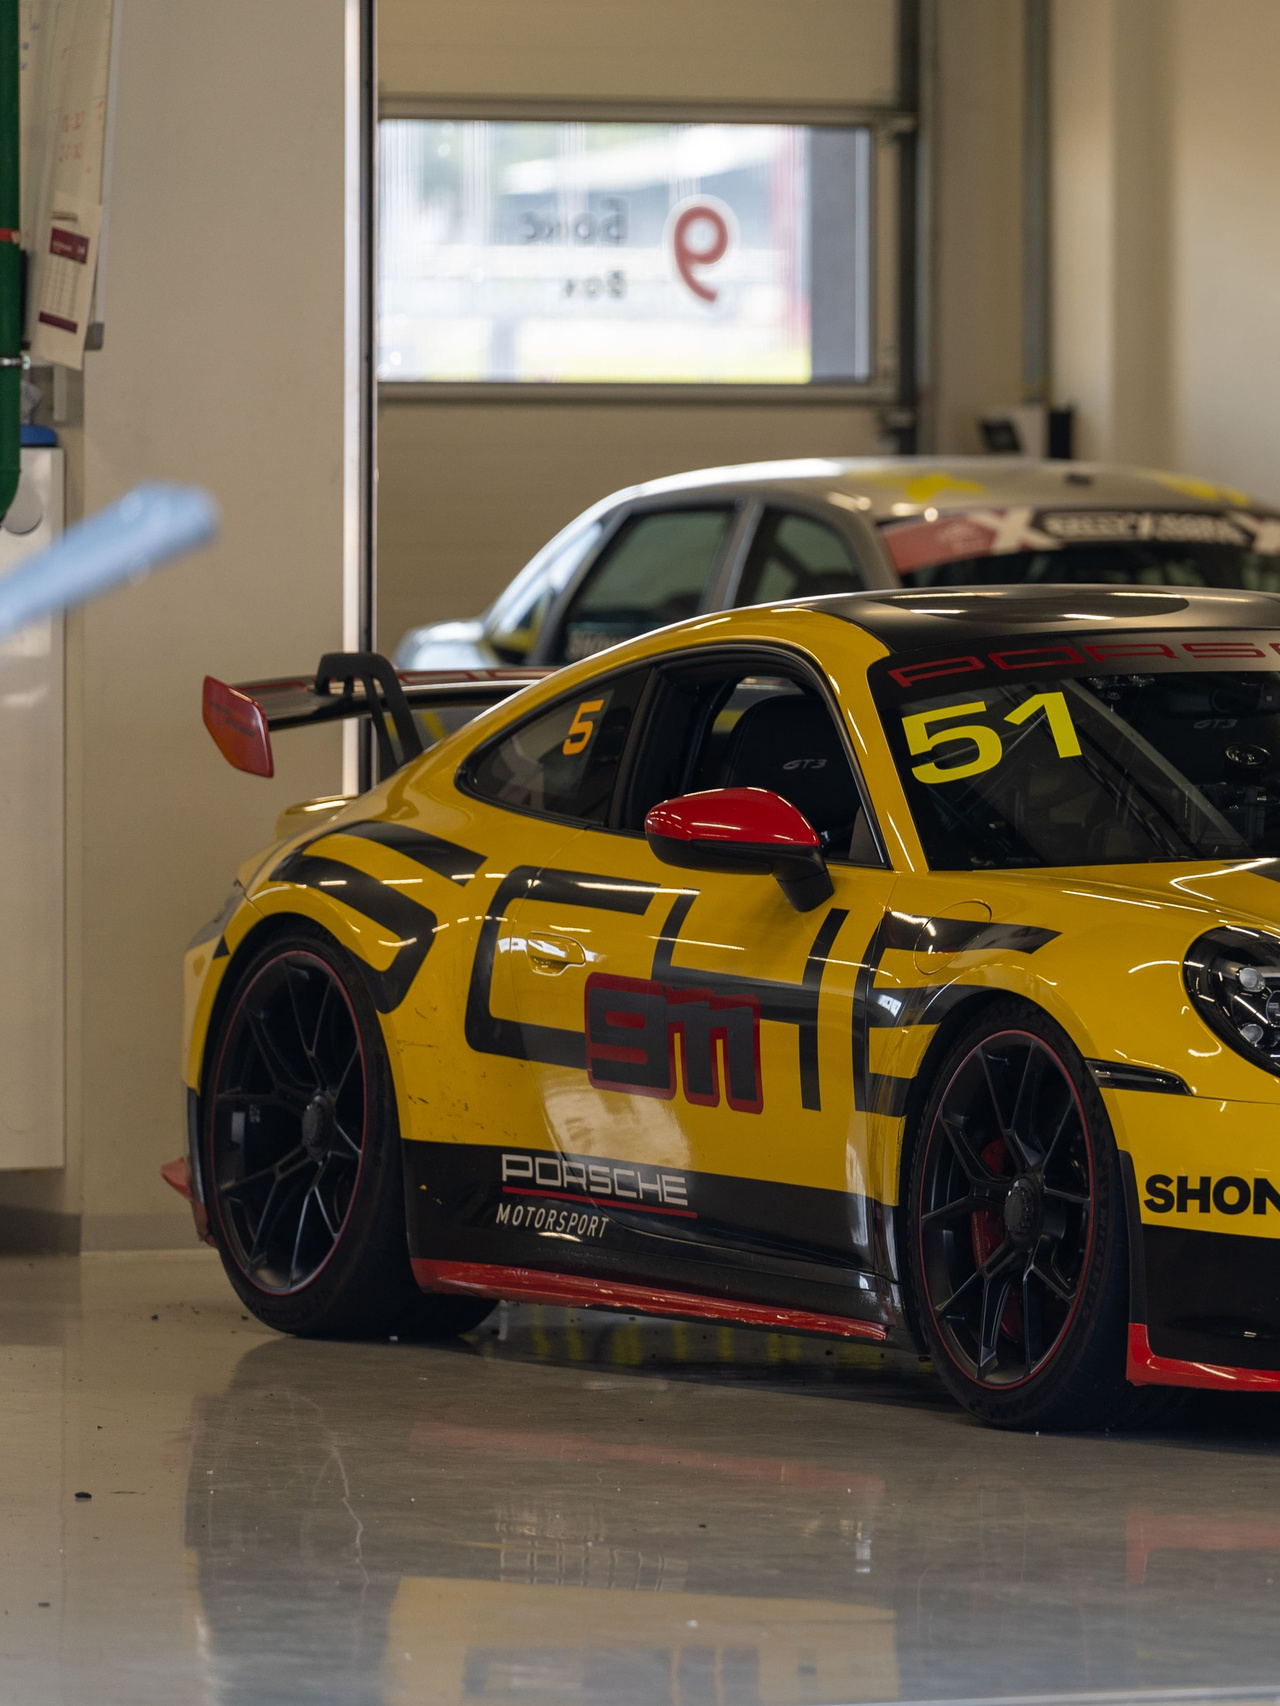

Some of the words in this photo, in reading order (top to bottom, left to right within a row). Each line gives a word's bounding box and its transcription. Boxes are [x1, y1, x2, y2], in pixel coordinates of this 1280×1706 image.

[562, 699, 605, 756] 5
[901, 690, 1083, 785] 51
[1192, 718, 1239, 730] GT3
[782, 757, 828, 771] GT3
[501, 1153, 689, 1207] PORSCHE
[495, 1202, 611, 1239] MOTORSPORT
